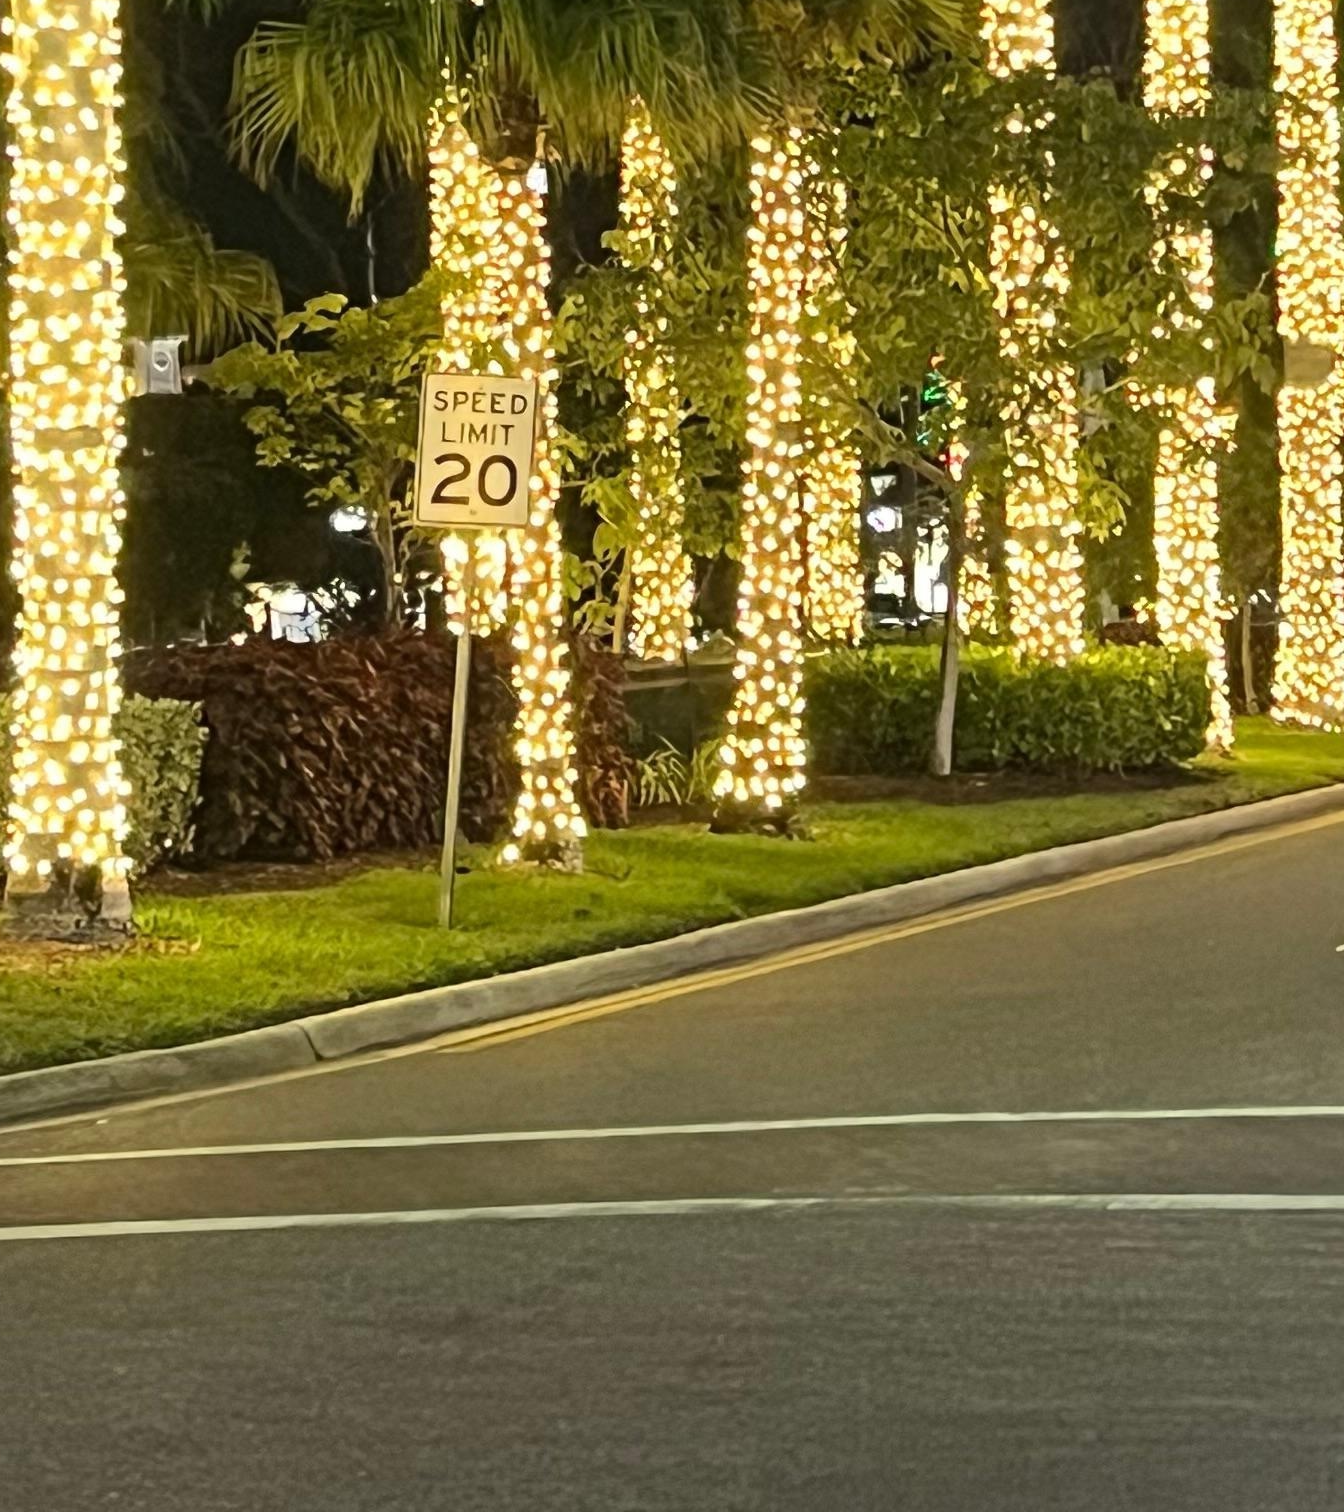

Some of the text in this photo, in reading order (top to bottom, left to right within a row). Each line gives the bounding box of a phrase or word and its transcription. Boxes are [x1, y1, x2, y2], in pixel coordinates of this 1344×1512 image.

[433, 390, 528, 415] SPEED
[441, 421, 515, 446] LIMIT
[430, 452, 518, 507] 20
